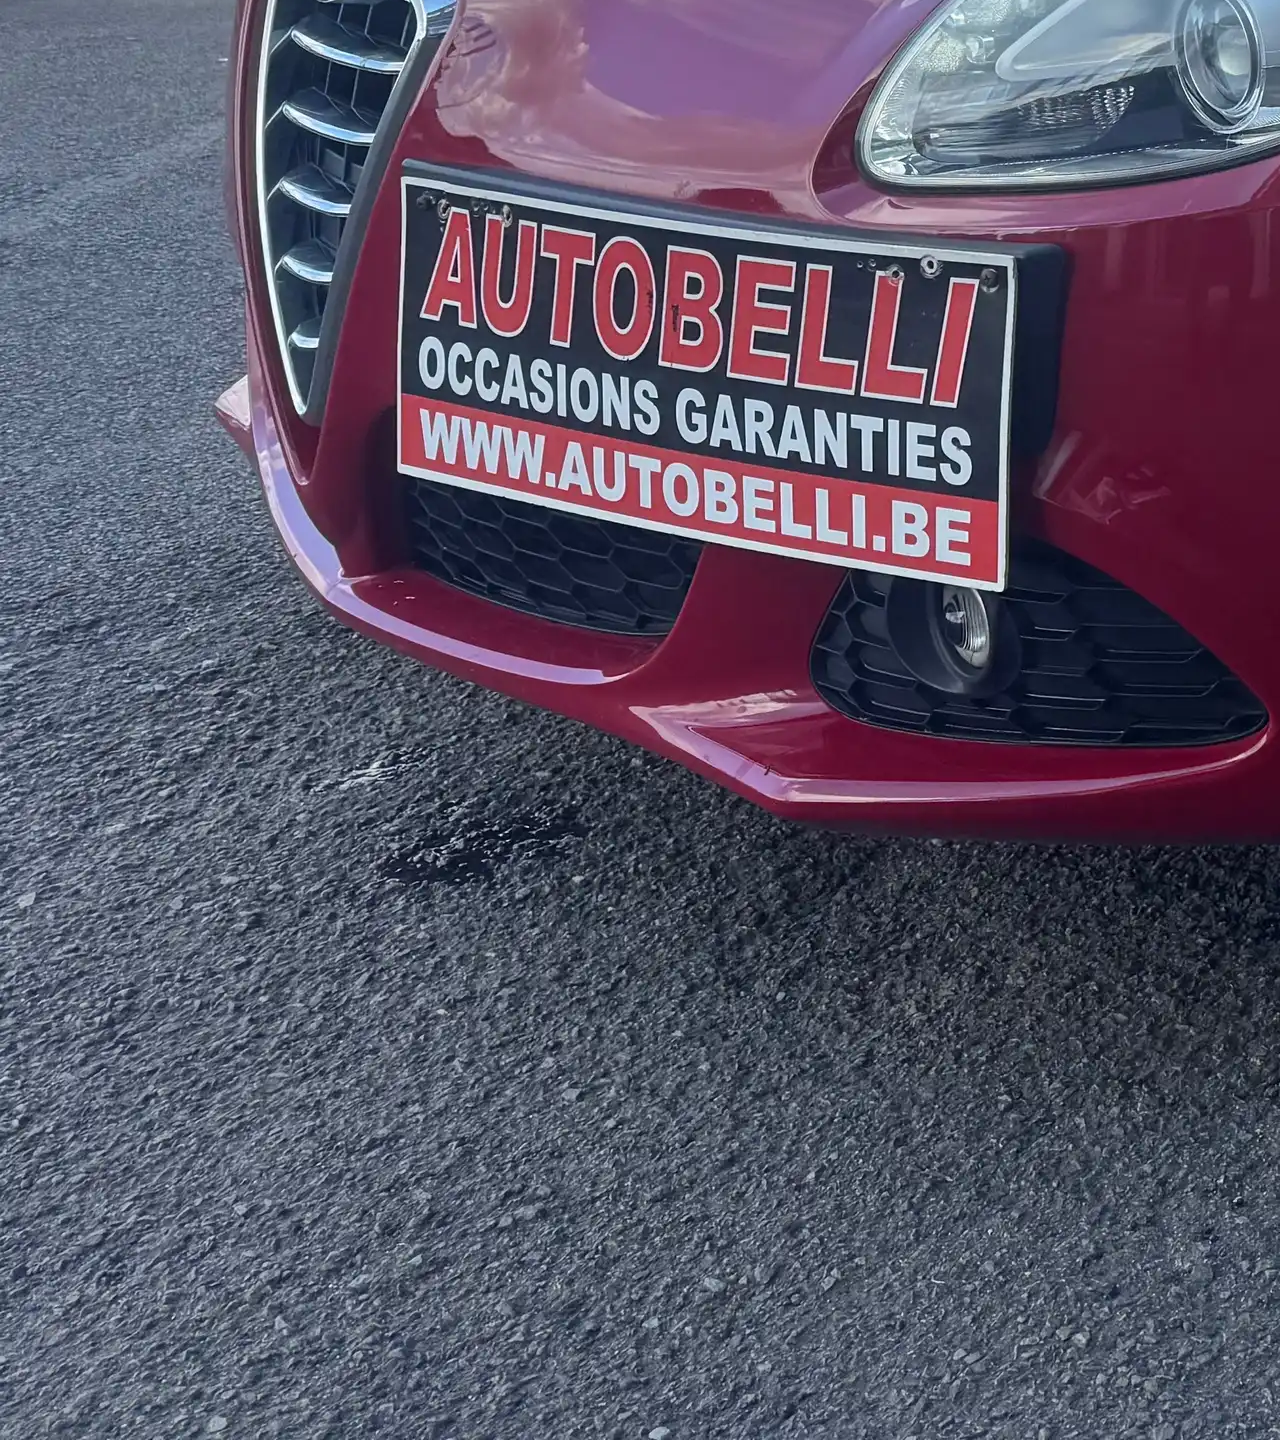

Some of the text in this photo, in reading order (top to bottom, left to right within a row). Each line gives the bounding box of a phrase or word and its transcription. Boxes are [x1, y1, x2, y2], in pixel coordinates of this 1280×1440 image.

[419, 207, 980, 408] AUTOBELLI
[418, 336, 972, 486] OCCASIONS GARANTIES
[419, 409, 972, 566] WWW.AUTOBELLI.BE
